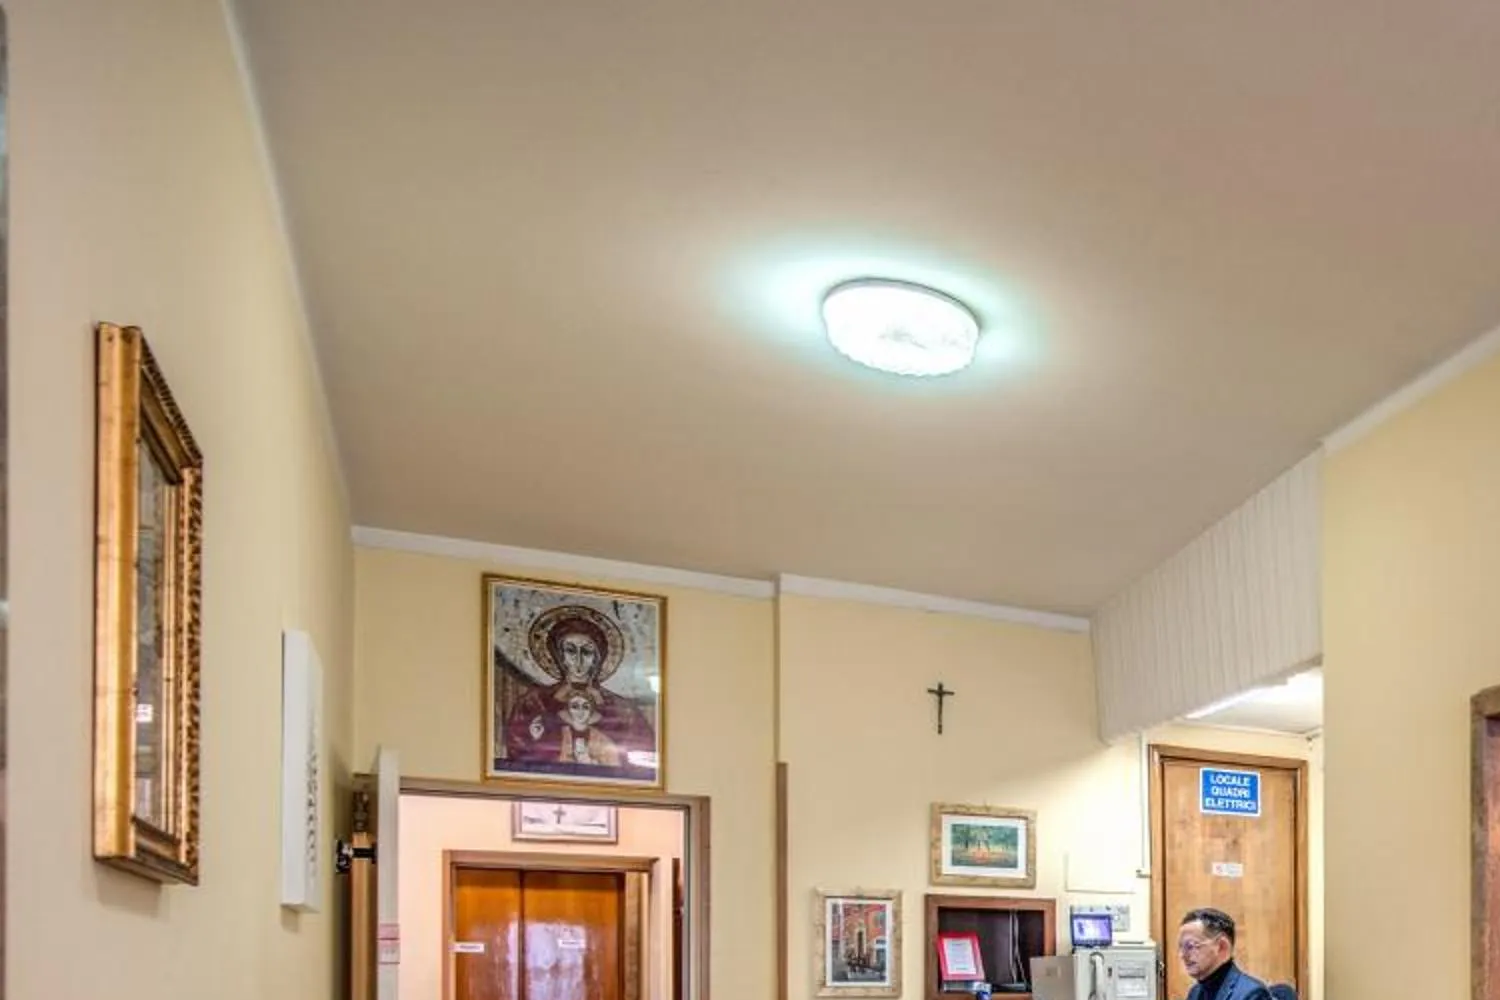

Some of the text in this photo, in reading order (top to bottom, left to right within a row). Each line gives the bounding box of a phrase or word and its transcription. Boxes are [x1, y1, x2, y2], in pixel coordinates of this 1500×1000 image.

[1209, 773, 1251, 786] LOCALE
[1211, 785, 1251, 798] QUADRI
[1205, 797, 1256, 810] ELETTRICI
